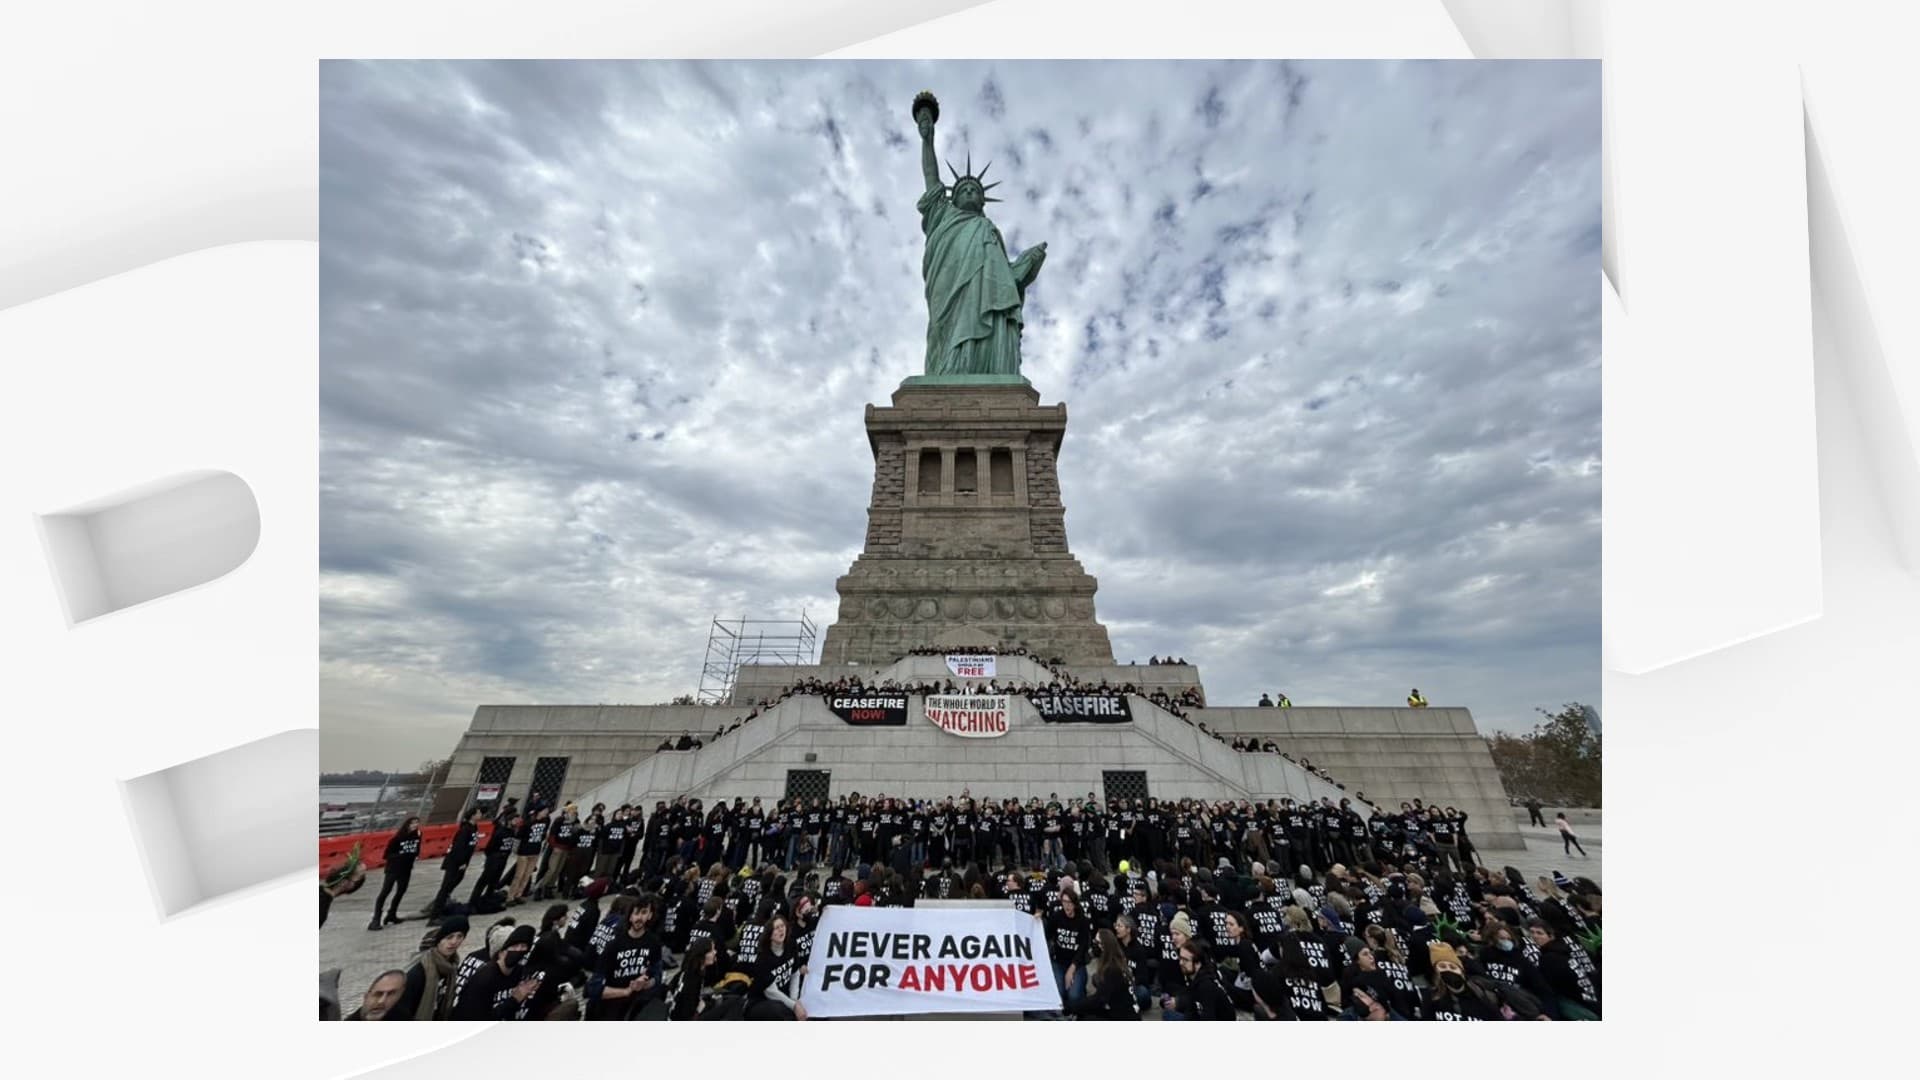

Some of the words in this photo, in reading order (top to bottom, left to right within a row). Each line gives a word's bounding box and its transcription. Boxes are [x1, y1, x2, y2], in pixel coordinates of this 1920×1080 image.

[957, 667, 985, 676] FREE
[833, 698, 905, 709] CEASEFIRE
[928, 698, 942, 709] THE
[943, 698, 968, 710] WHOLE
[969, 698, 996, 710] WORLD
[997, 698, 1006, 709] IS
[851, 710, 886, 721] NOW!
[928, 709, 1006, 733] WATCHING
[1210, 911, 1226, 919] JEW
[1259, 924, 1282, 933] NOW
[800, 939, 813, 950] OU
[826, 931, 932, 959] NEVER
[938, 934, 1033, 961] AGAIN
[1299, 941, 1324, 951] EASE
[616, 949, 638, 960] NOT
[640, 948, 650, 956] IN
[737, 954, 758, 963] NOW
[1162, 950, 1179, 960] NO
[620, 957, 644, 968] OUR
[1308, 956, 1329, 968] OW
[821, 963, 891, 992] FOR
[897, 963, 1041, 992] ANYONE
[1394, 979, 1413, 991] OW
[1290, 996, 1322, 1012] NOW
